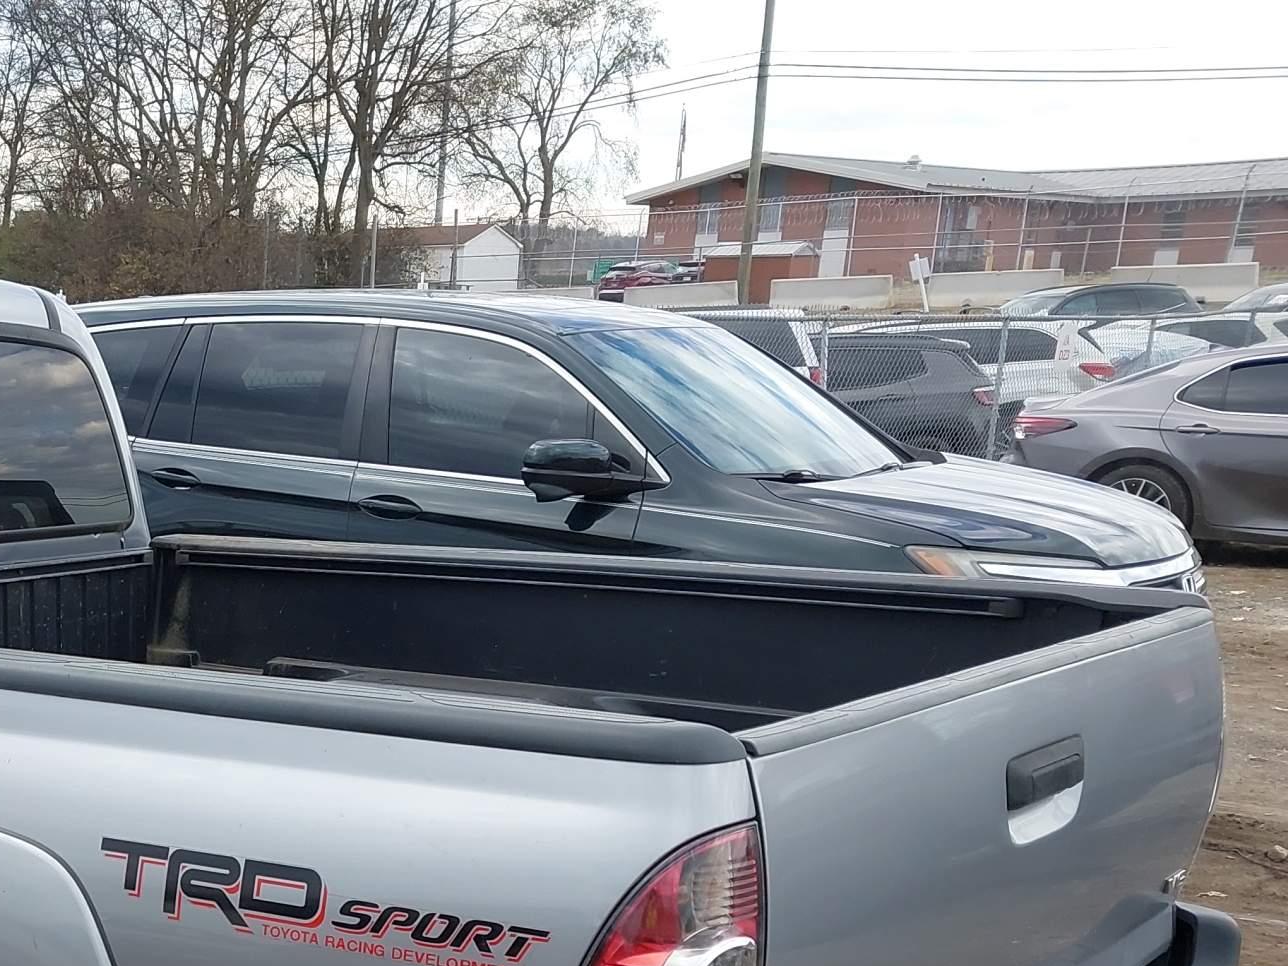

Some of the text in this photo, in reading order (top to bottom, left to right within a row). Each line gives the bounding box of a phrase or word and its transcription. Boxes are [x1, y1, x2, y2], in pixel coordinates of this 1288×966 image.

[99, 836, 551, 963] TRD SPORT
[261, 923, 320, 946] TOYOTA
[324, 935, 386, 958] RACING
